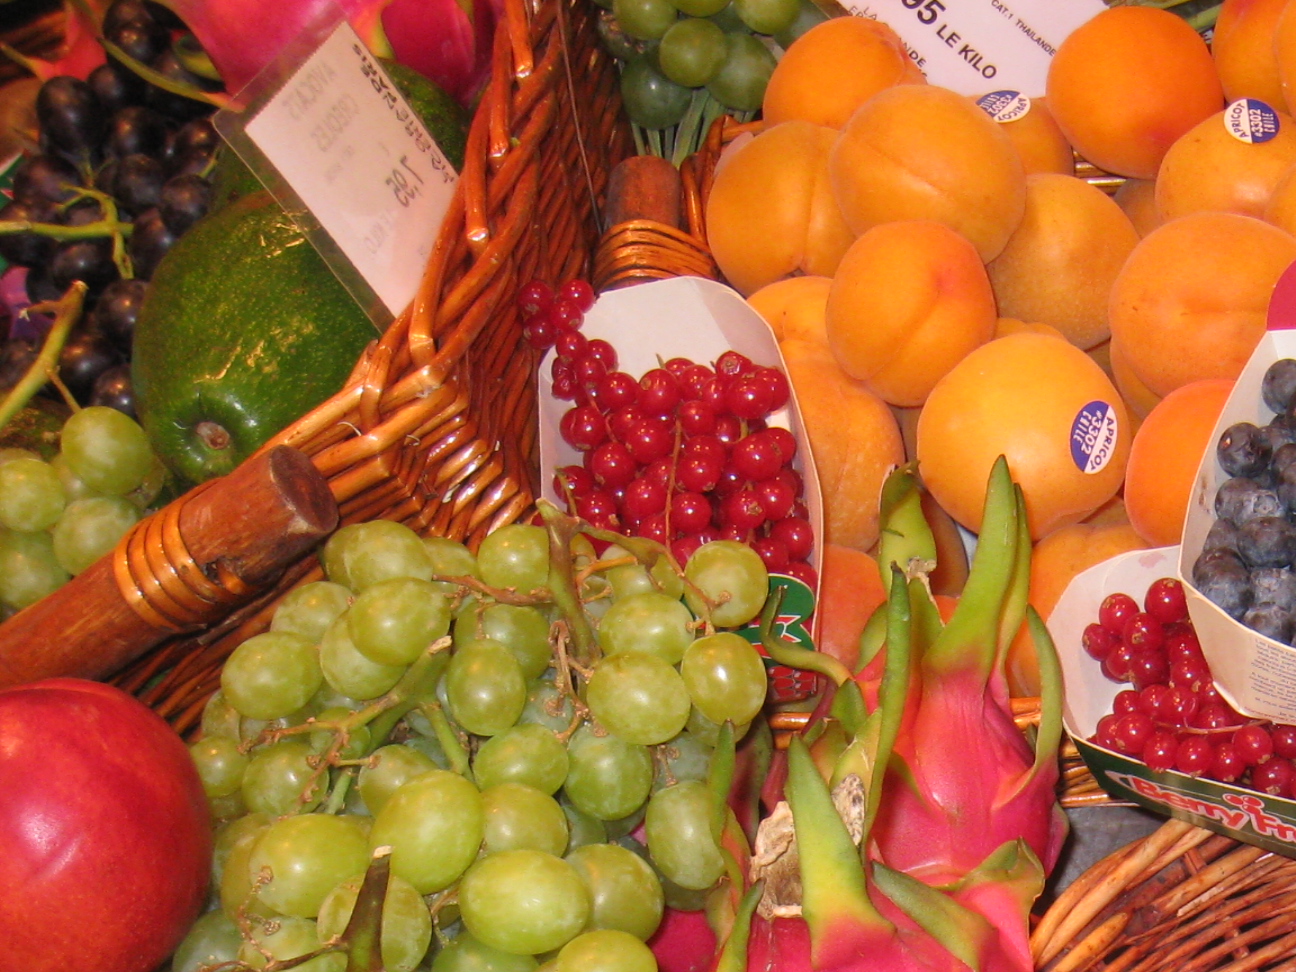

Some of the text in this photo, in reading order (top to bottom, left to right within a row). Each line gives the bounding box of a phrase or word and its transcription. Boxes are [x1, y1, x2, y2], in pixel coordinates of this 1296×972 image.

[936, 24, 961, 48] LE
[958, 44, 997, 80] KILO
[991, 0, 1057, 57] CAT.1 THAILANDE
[352, 43, 397, 104] PARIS
[998, 97, 1027, 121] APRICOT
[1230, 103, 1249, 138] APRICOT
[1080, 409, 1103, 455] #3302
[1089, 416, 1115, 471] APRICOT
[1128, 774, 1245, 830] Berry
